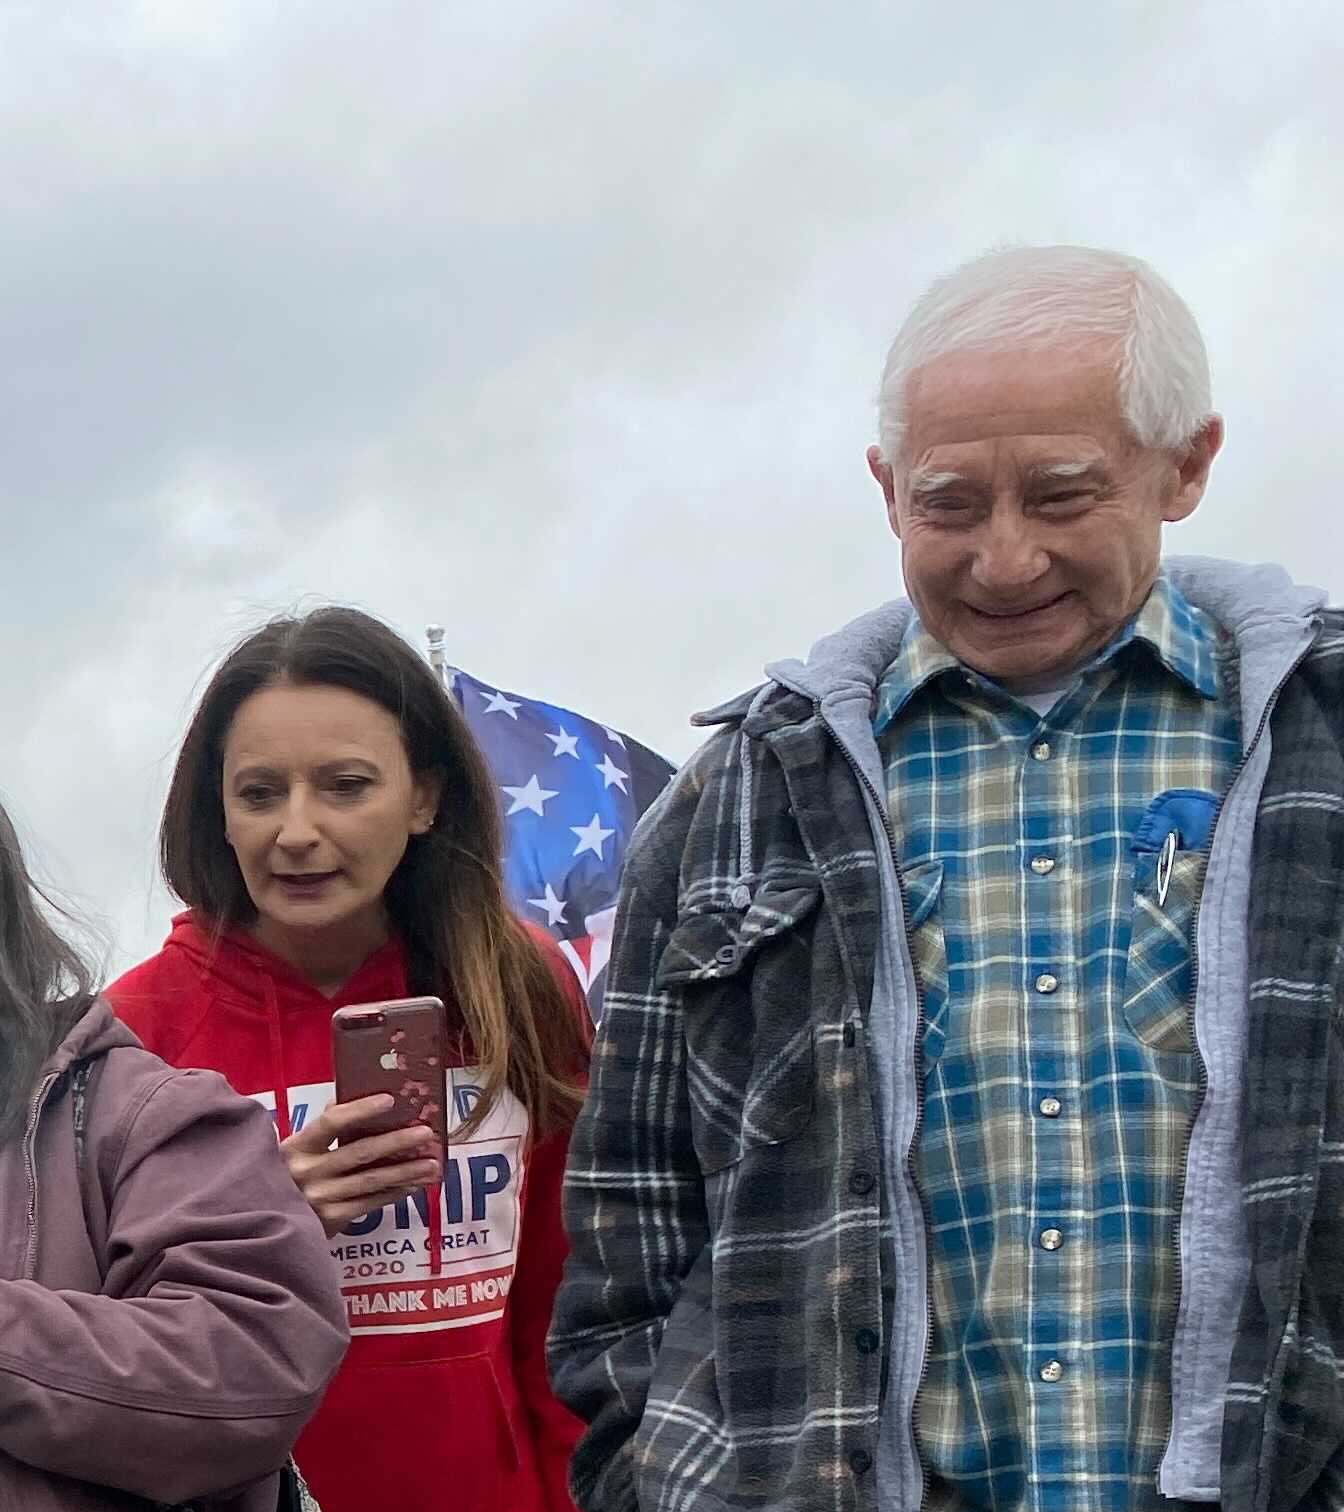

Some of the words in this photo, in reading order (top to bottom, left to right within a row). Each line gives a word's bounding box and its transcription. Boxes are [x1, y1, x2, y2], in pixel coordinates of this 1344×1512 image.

[343, 1260, 406, 1279] 2020
[342, 1290, 427, 1315] THANK
[433, 1284, 468, 1309] ME
